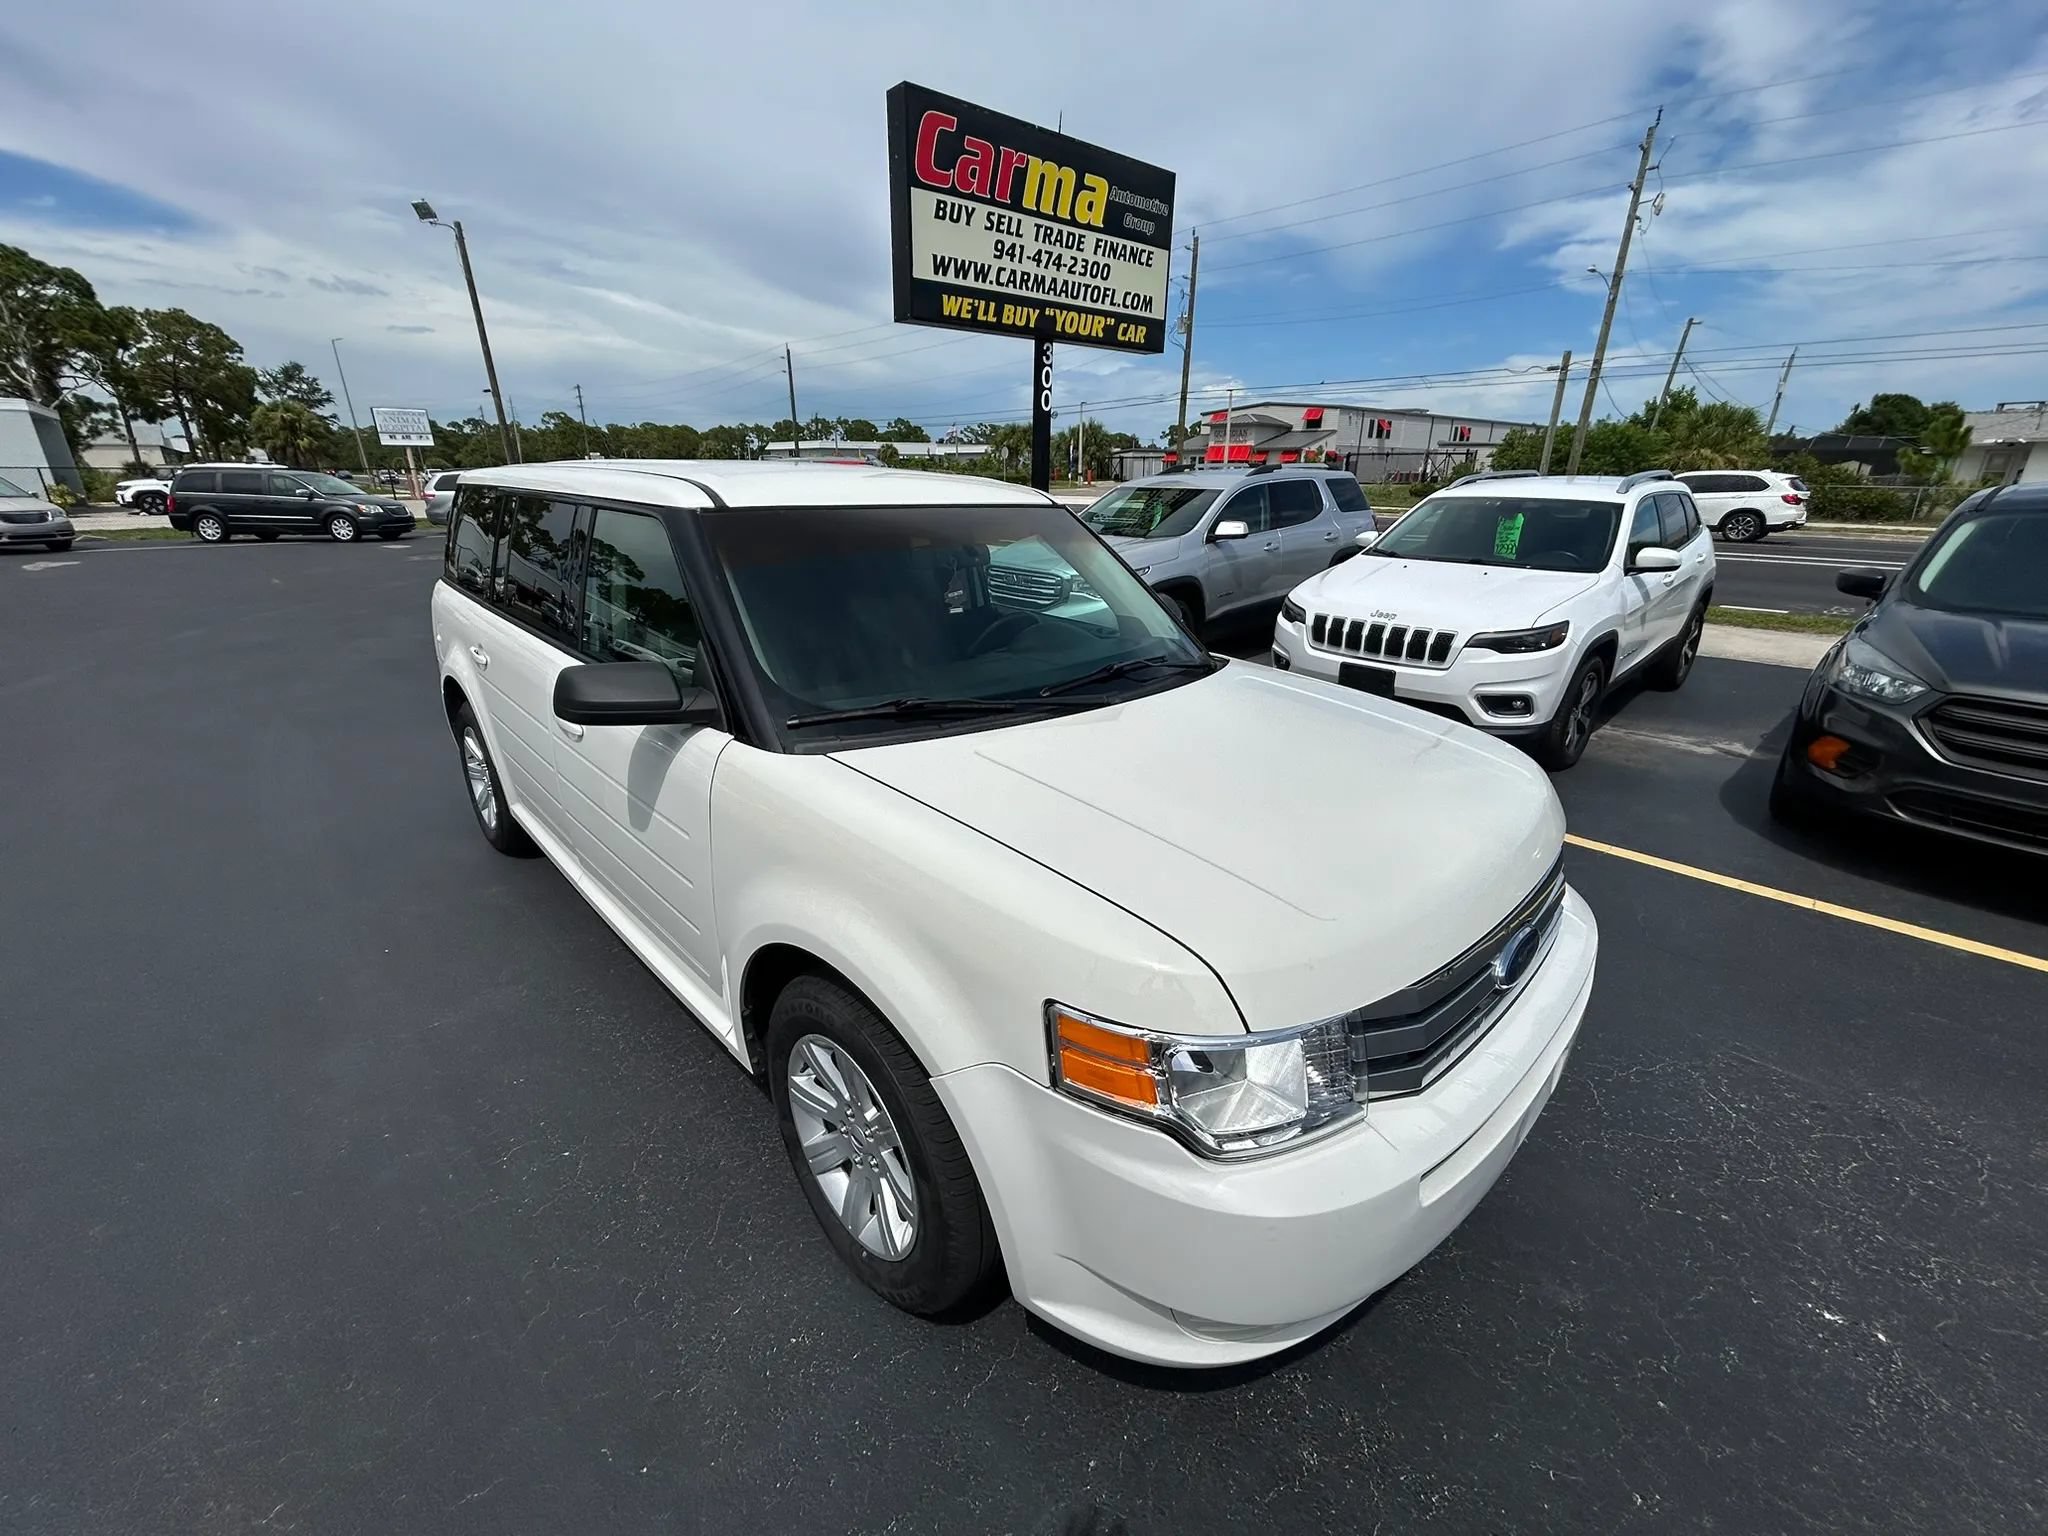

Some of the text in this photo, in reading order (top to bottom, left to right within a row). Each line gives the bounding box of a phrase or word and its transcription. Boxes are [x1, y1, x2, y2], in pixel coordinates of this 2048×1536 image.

[915, 110, 1110, 228] Carma
[1109, 185, 1169, 216] Automotive
[934, 198, 1154, 268] BUY SELL TRADE FINANCE
[1123, 212, 1155, 235] Group
[993, 239, 1111, 281] 941-474-2300
[932, 253, 1153, 313] WWW.CARMAAUTOFL.COM
[942, 294, 997, 323] WE'LL
[1002, 306, 1040, 329] BUY
[1117, 322, 1147, 344] CAR
[1041, 342, 1053, 412] 300
[379, 423, 427, 432] HOSPITAL
[382, 416, 424, 424] ANIMAL
[1370, 609, 1397, 621] Jeep
